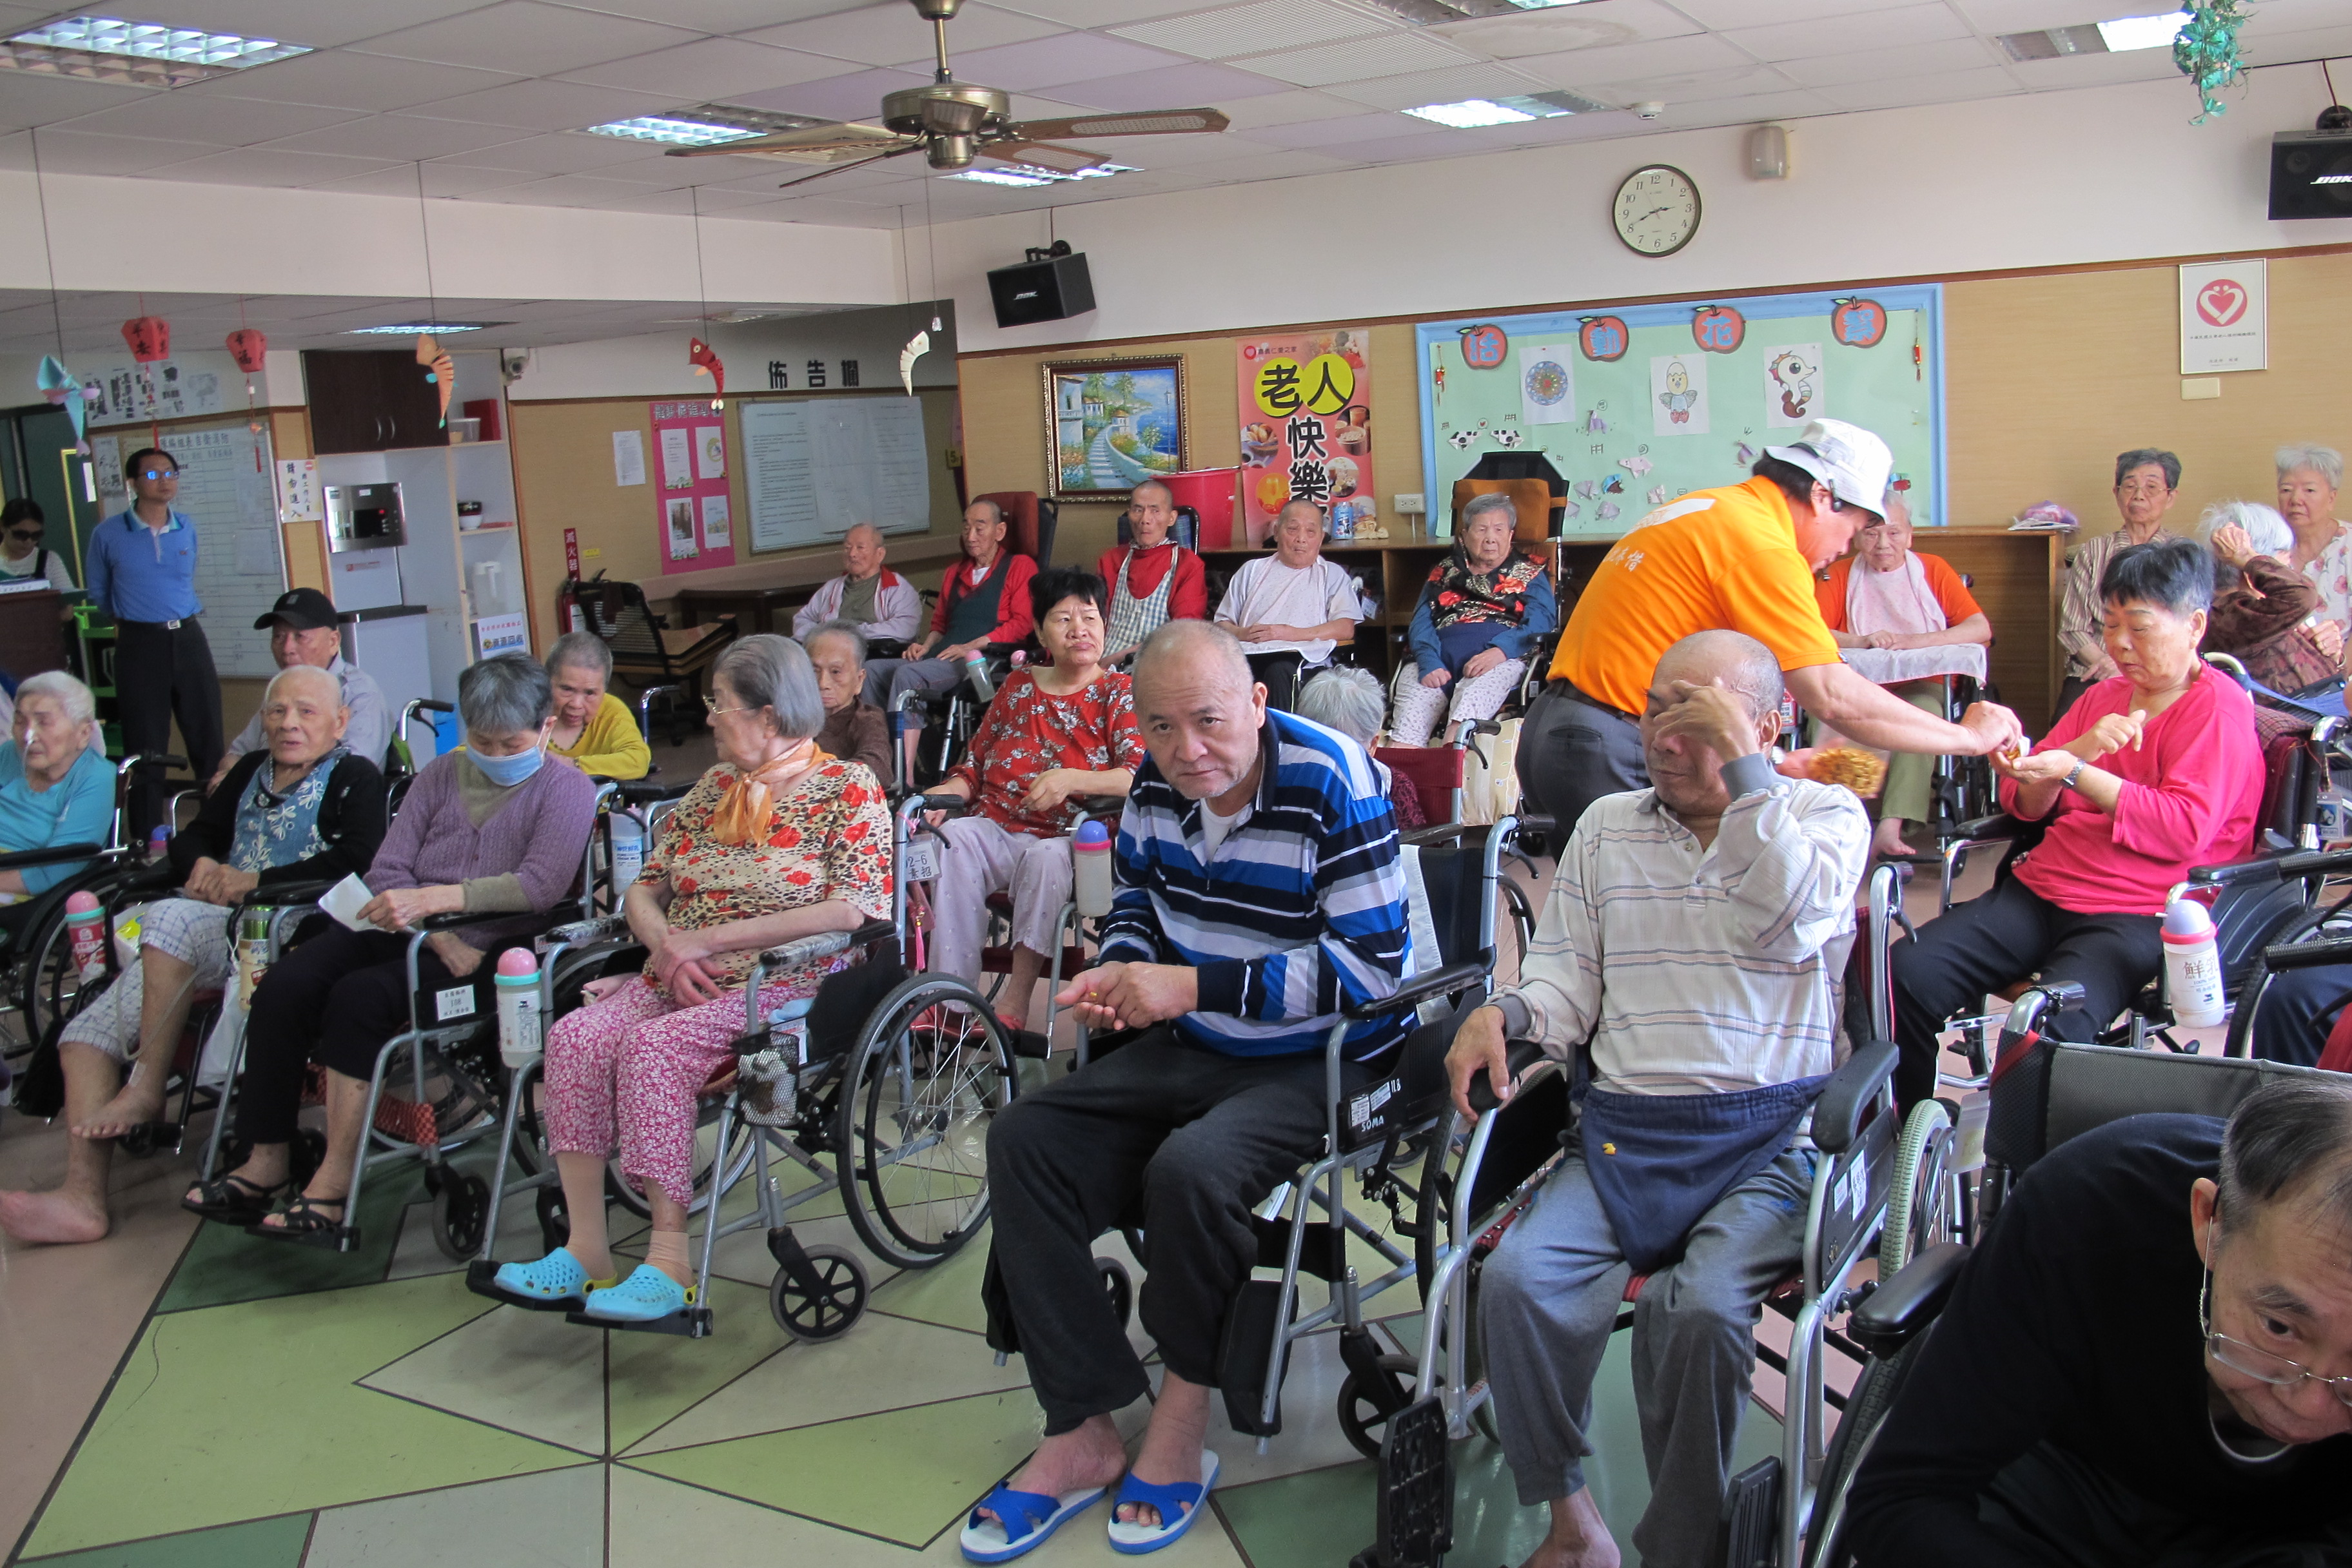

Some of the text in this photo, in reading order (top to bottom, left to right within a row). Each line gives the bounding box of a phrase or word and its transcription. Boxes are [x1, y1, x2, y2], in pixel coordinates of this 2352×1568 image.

[1651, 175, 1661, 184] 12
[1670, 178, 1674, 187] 1
[1636, 181, 1643, 190] 11
[1680, 188, 1686, 197] 2
[1625, 195, 1635, 204] 10
[1685, 204, 1692, 213] 3
[1622, 210, 1629, 219] 9
[1681, 219, 1687, 228] 4
[1627, 224, 1634, 233] 8
[1638, 235, 1644, 244] 7
[1669, 233, 1677, 242] 5
[1654, 239, 1661, 248] 6
[768, 360, 859, 389] 佈告欄
[1261, 361, 1348, 409] 老人
[1288, 416, 1328, 514] 快樂
[2182, 955, 2219, 979] 鮮乳
[1361, 1115, 1384, 1132] SOMA
